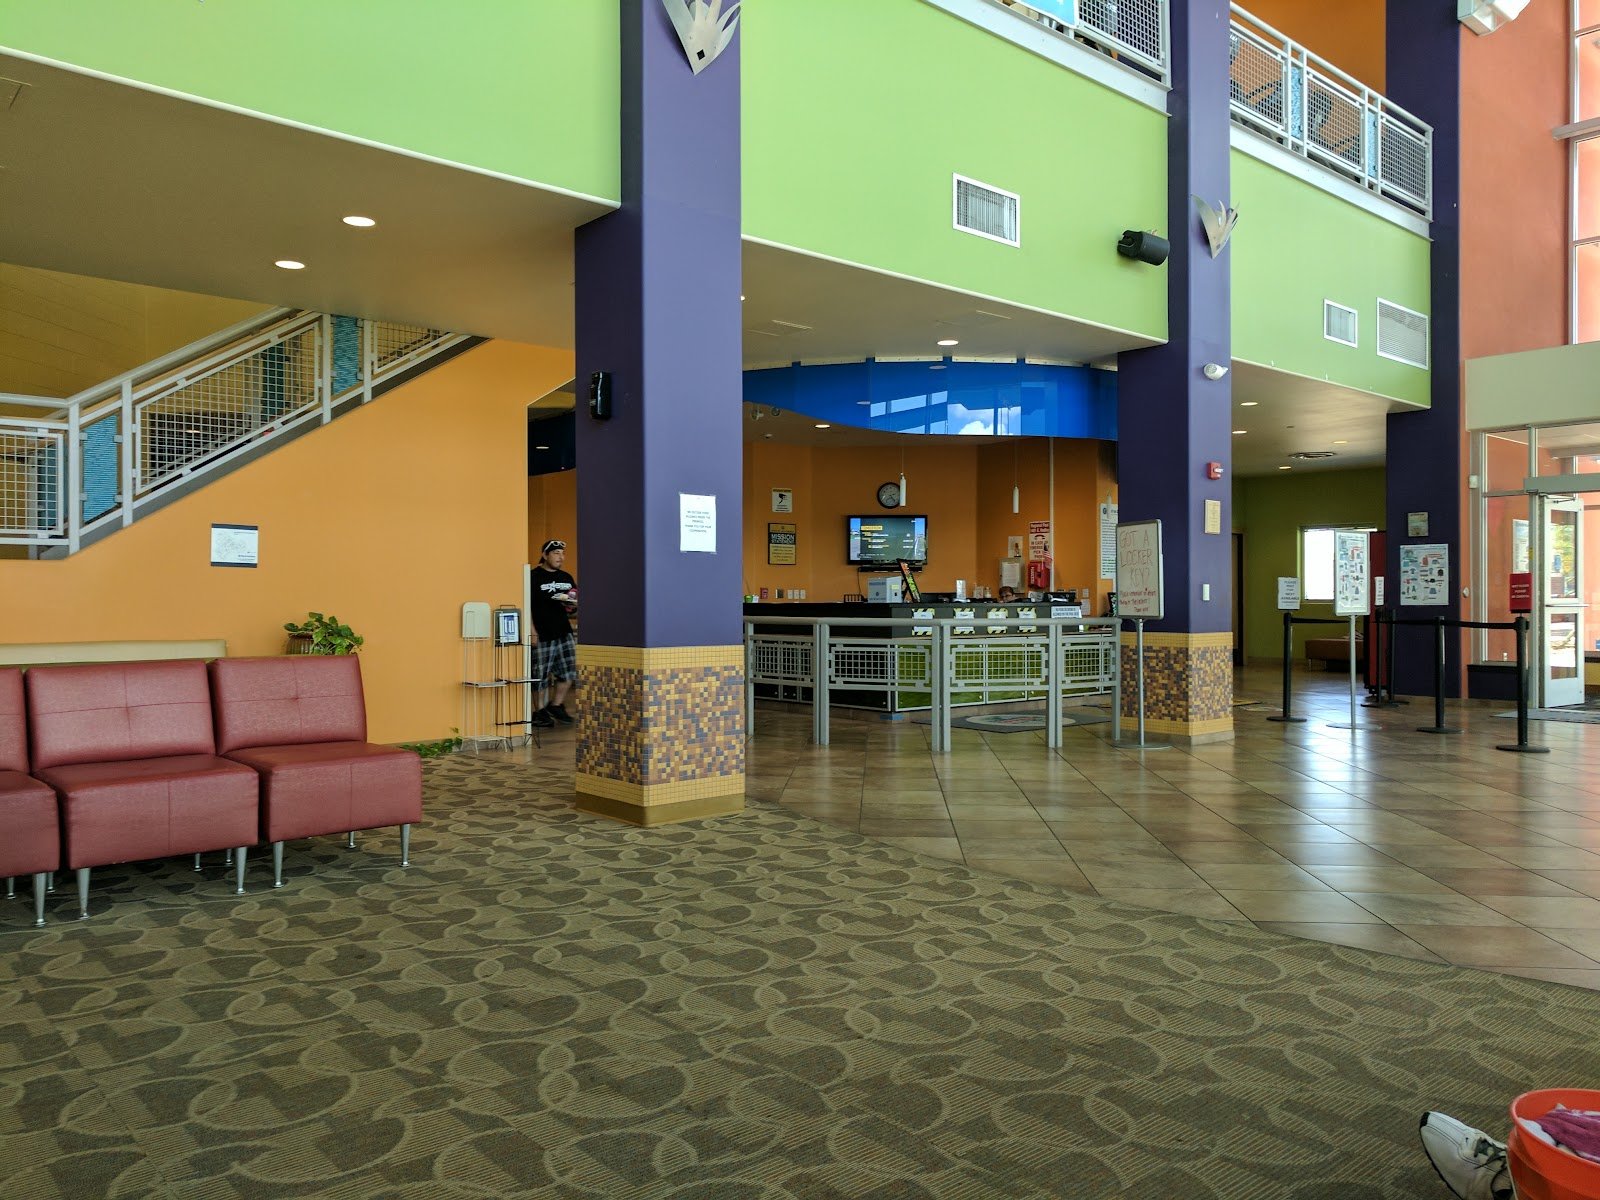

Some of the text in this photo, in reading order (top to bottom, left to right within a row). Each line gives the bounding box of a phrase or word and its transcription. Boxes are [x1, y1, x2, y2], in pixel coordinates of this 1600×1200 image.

[1120, 530, 1150, 548] GOT A
[1120, 549, 1153, 567] LOCKER
